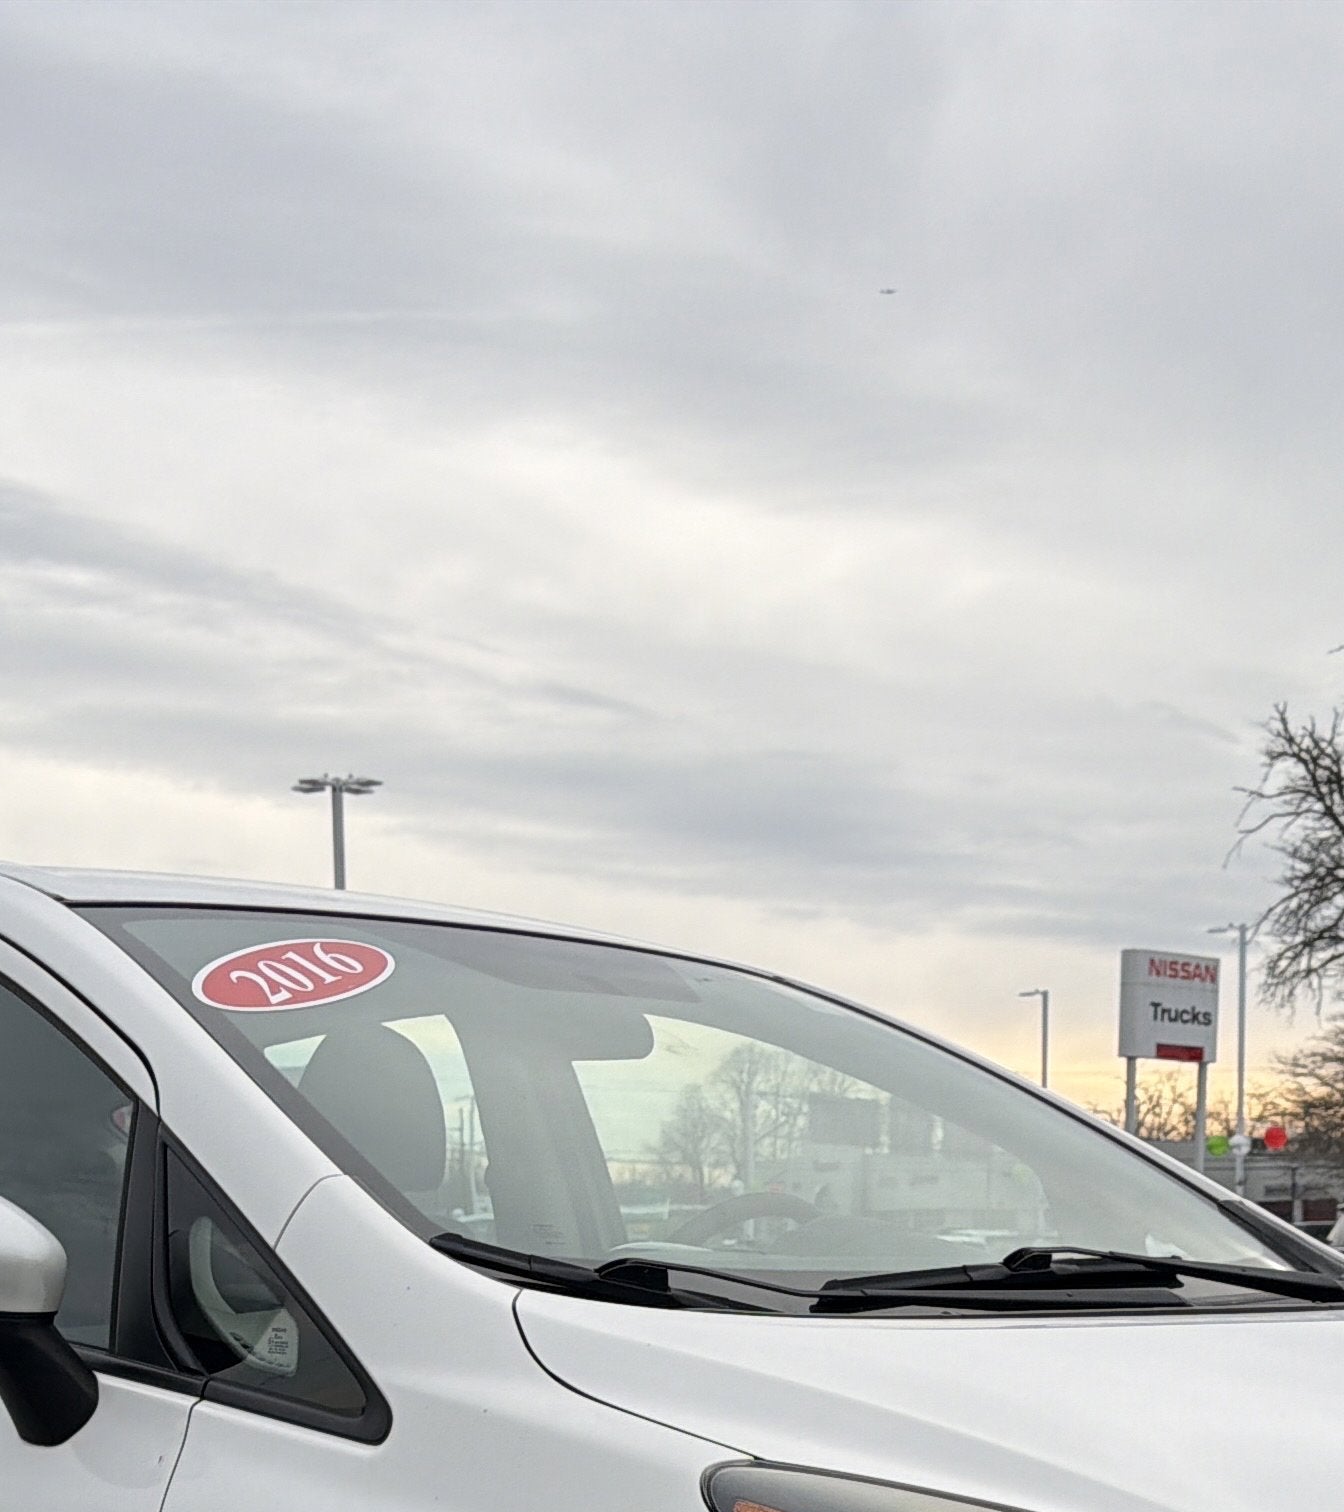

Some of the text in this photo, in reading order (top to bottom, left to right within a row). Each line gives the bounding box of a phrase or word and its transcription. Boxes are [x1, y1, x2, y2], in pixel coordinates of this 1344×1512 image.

[229, 942, 364, 1005] 2016
[1147, 958, 1217, 984] NISSAN
[1149, 1001, 1213, 1027] Trucks
